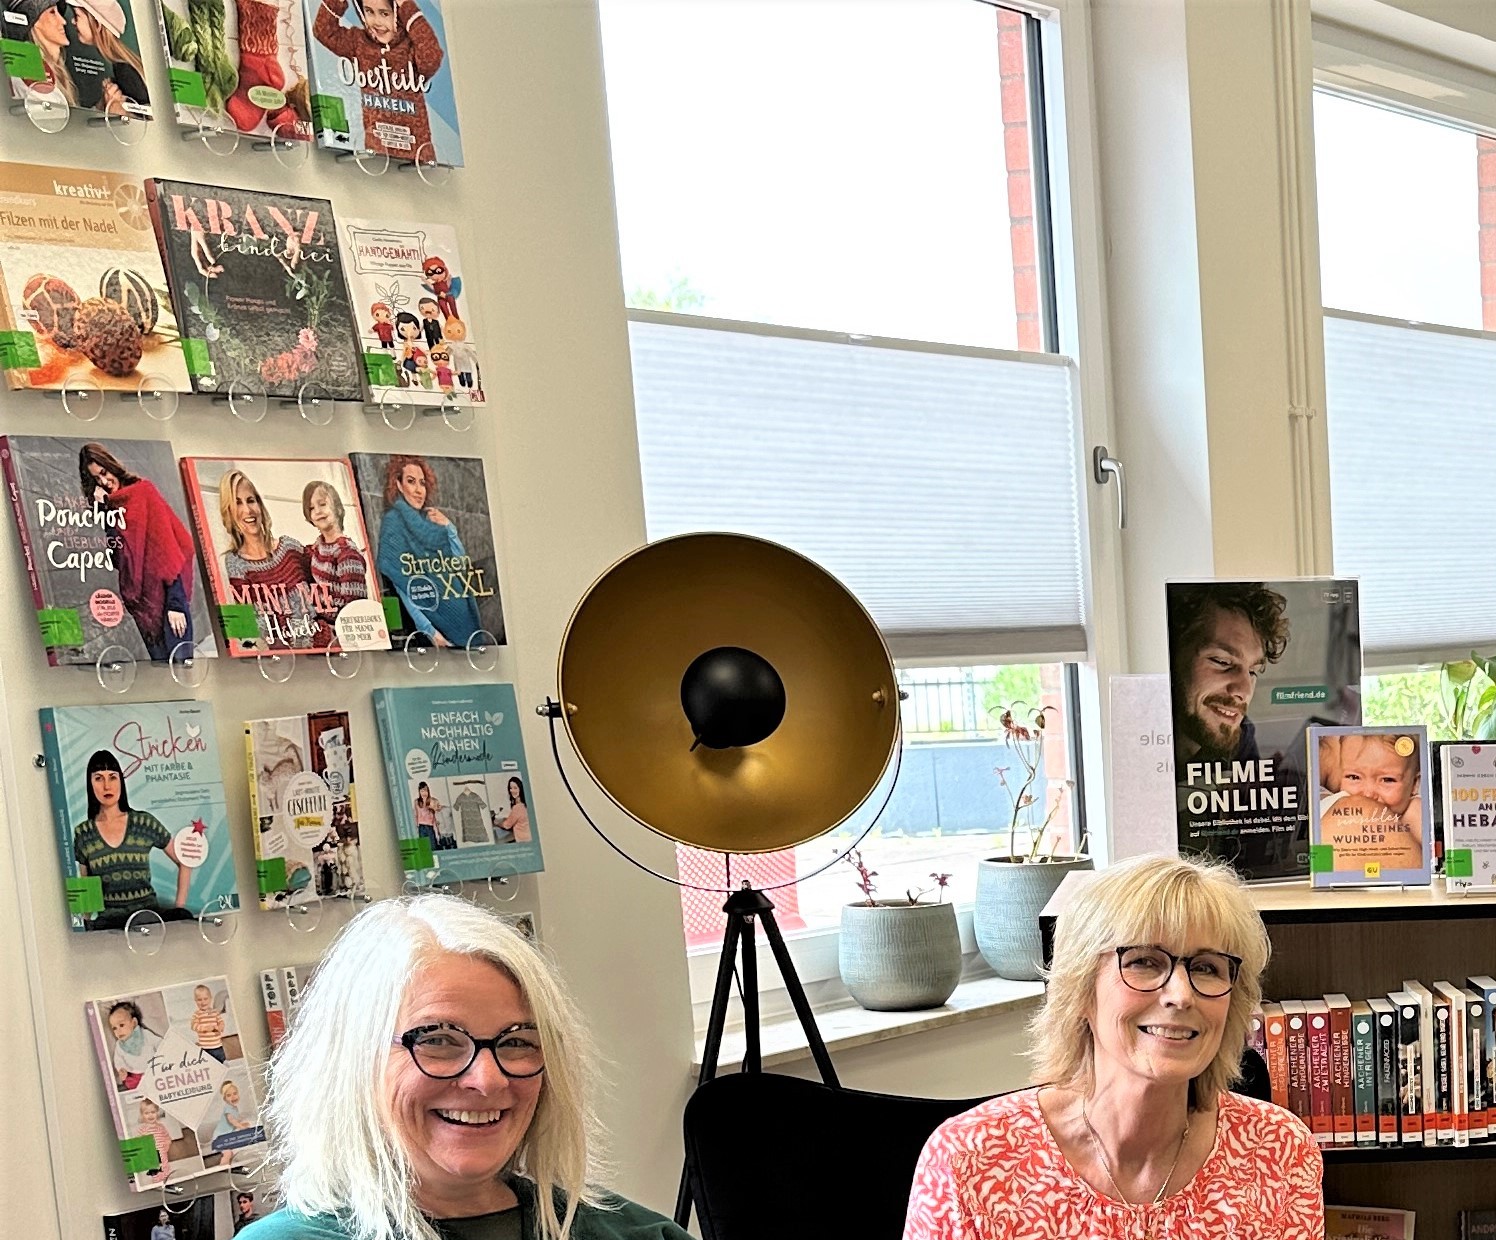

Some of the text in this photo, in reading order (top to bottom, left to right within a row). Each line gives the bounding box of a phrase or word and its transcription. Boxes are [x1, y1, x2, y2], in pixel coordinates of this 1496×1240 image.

[0, 211, 118, 235] Filzen mit der Nadel
[35, 499, 127, 530] Ponchos
[47, 540, 114, 583] Capes
[400, 549, 474, 576] Stricken
[296, 581, 338, 614] ME
[437, 569, 494, 600] XXL
[421, 724, 494, 739] NACHHALTIG
[430, 711, 479, 725] EINFACH
[113, 716, 207, 779] Stricken
[1186, 759, 1275, 786] FILME
[1187, 787, 1298, 815] ONLINE
[1452, 788, 1479, 802] 100
[1478, 803, 1493, 811] AN
[1332, 807, 1363, 817] MEIN
[1332, 834, 1386, 844] WUNDER
[1362, 823, 1411, 834] KLEINES
[179, 1051, 208, 1069] dich
[1311, 1035, 1321, 1089] AACHENER
[1333, 1031, 1342, 1085] AACHENER
[1356, 1038, 1365, 1090] AACHENER
[1364, 1042, 1373, 1087] INTRIGEN
[154, 1066, 211, 1092] GENÄHT
